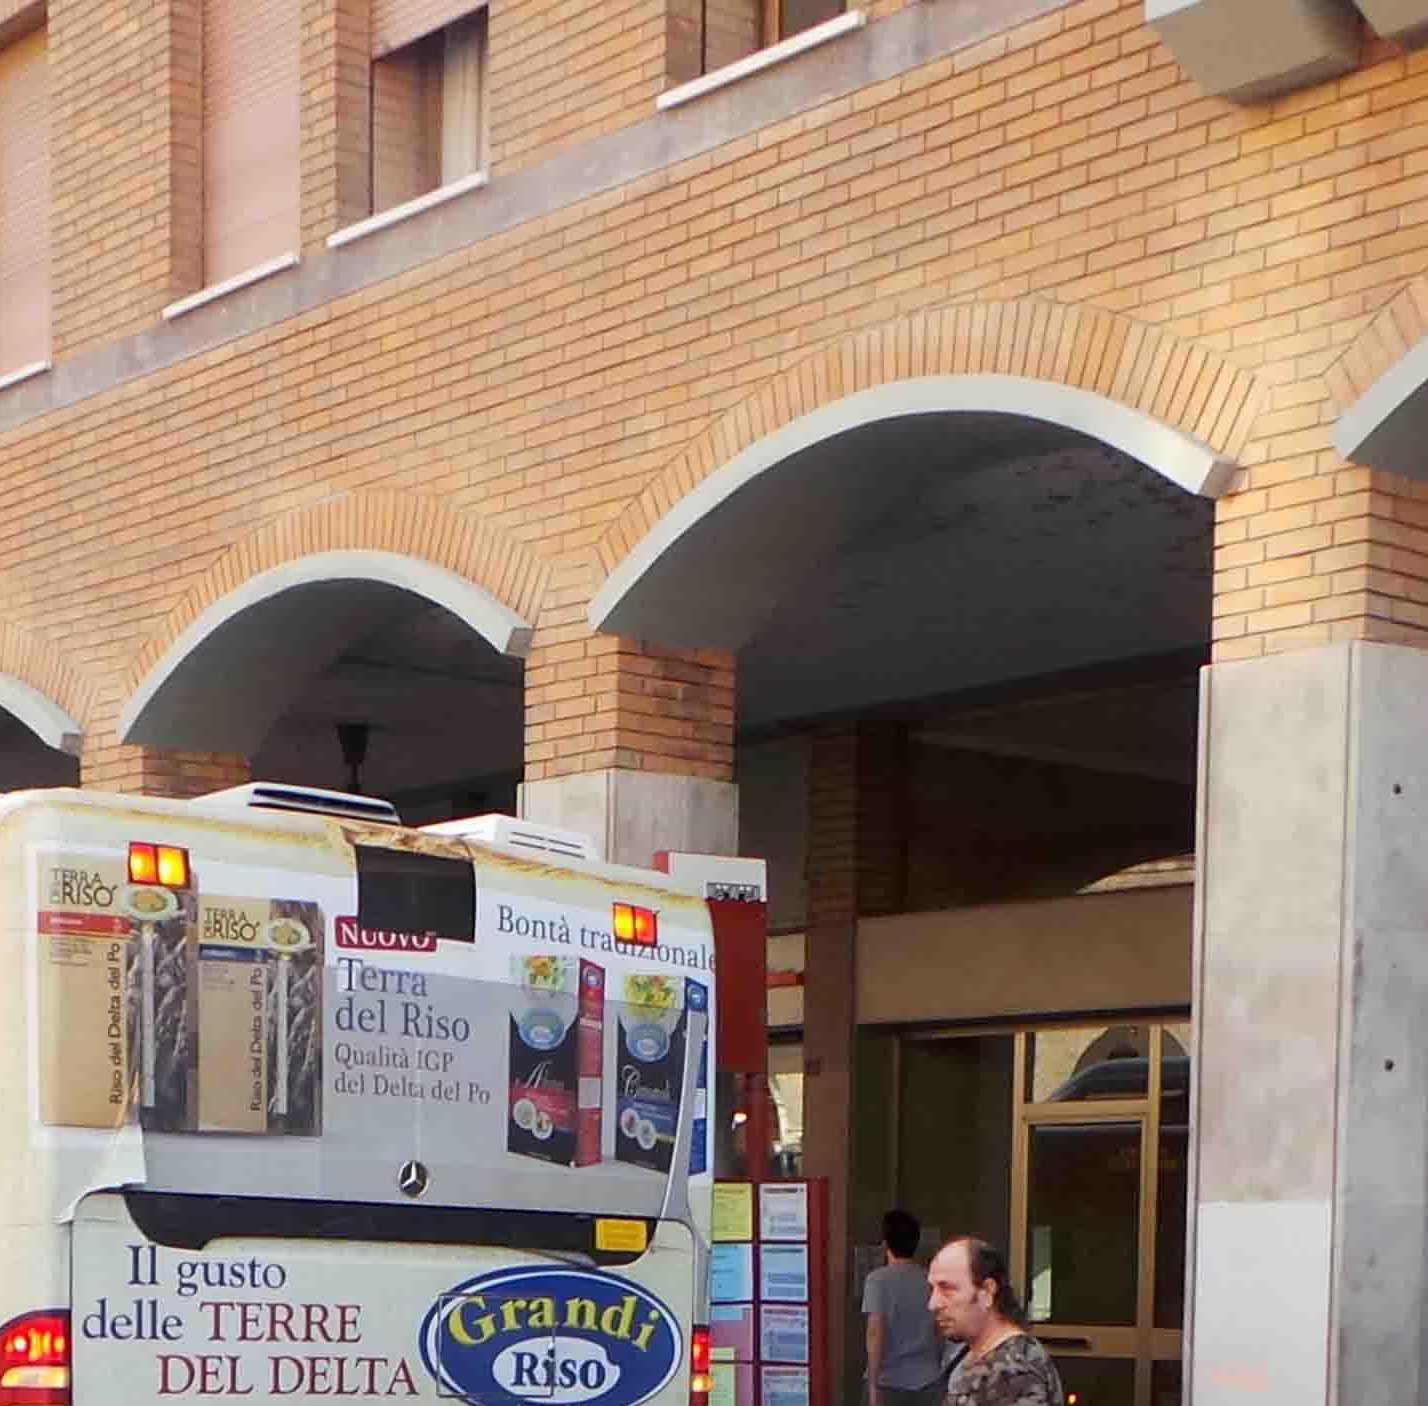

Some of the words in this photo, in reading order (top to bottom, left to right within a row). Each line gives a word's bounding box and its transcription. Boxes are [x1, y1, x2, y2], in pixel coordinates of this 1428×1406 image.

[497, 904, 571, 944] Bontà
[337, 957, 428, 997] Terra
[335, 998, 388, 1033] del
[401, 1001, 470, 1042] Riso
[334, 1043, 410, 1069] Qualità
[416, 1049, 454, 1072] IGP
[334, 1073, 365, 1094] del
[374, 1075, 423, 1098] Delta
[431, 1080, 461, 1101] del
[468, 1082, 491, 1104] Po
[126, 1245, 160, 1285] Il
[176, 1256, 286, 1297] gusto
[82, 1298, 183, 1341] delle
[199, 1301, 362, 1343] TERRE
[448, 1295, 661, 1352] Grandi
[156, 1355, 253, 1395] DEL
[268, 1356, 420, 1395] DELTA
[510, 1348, 607, 1389] Riso
